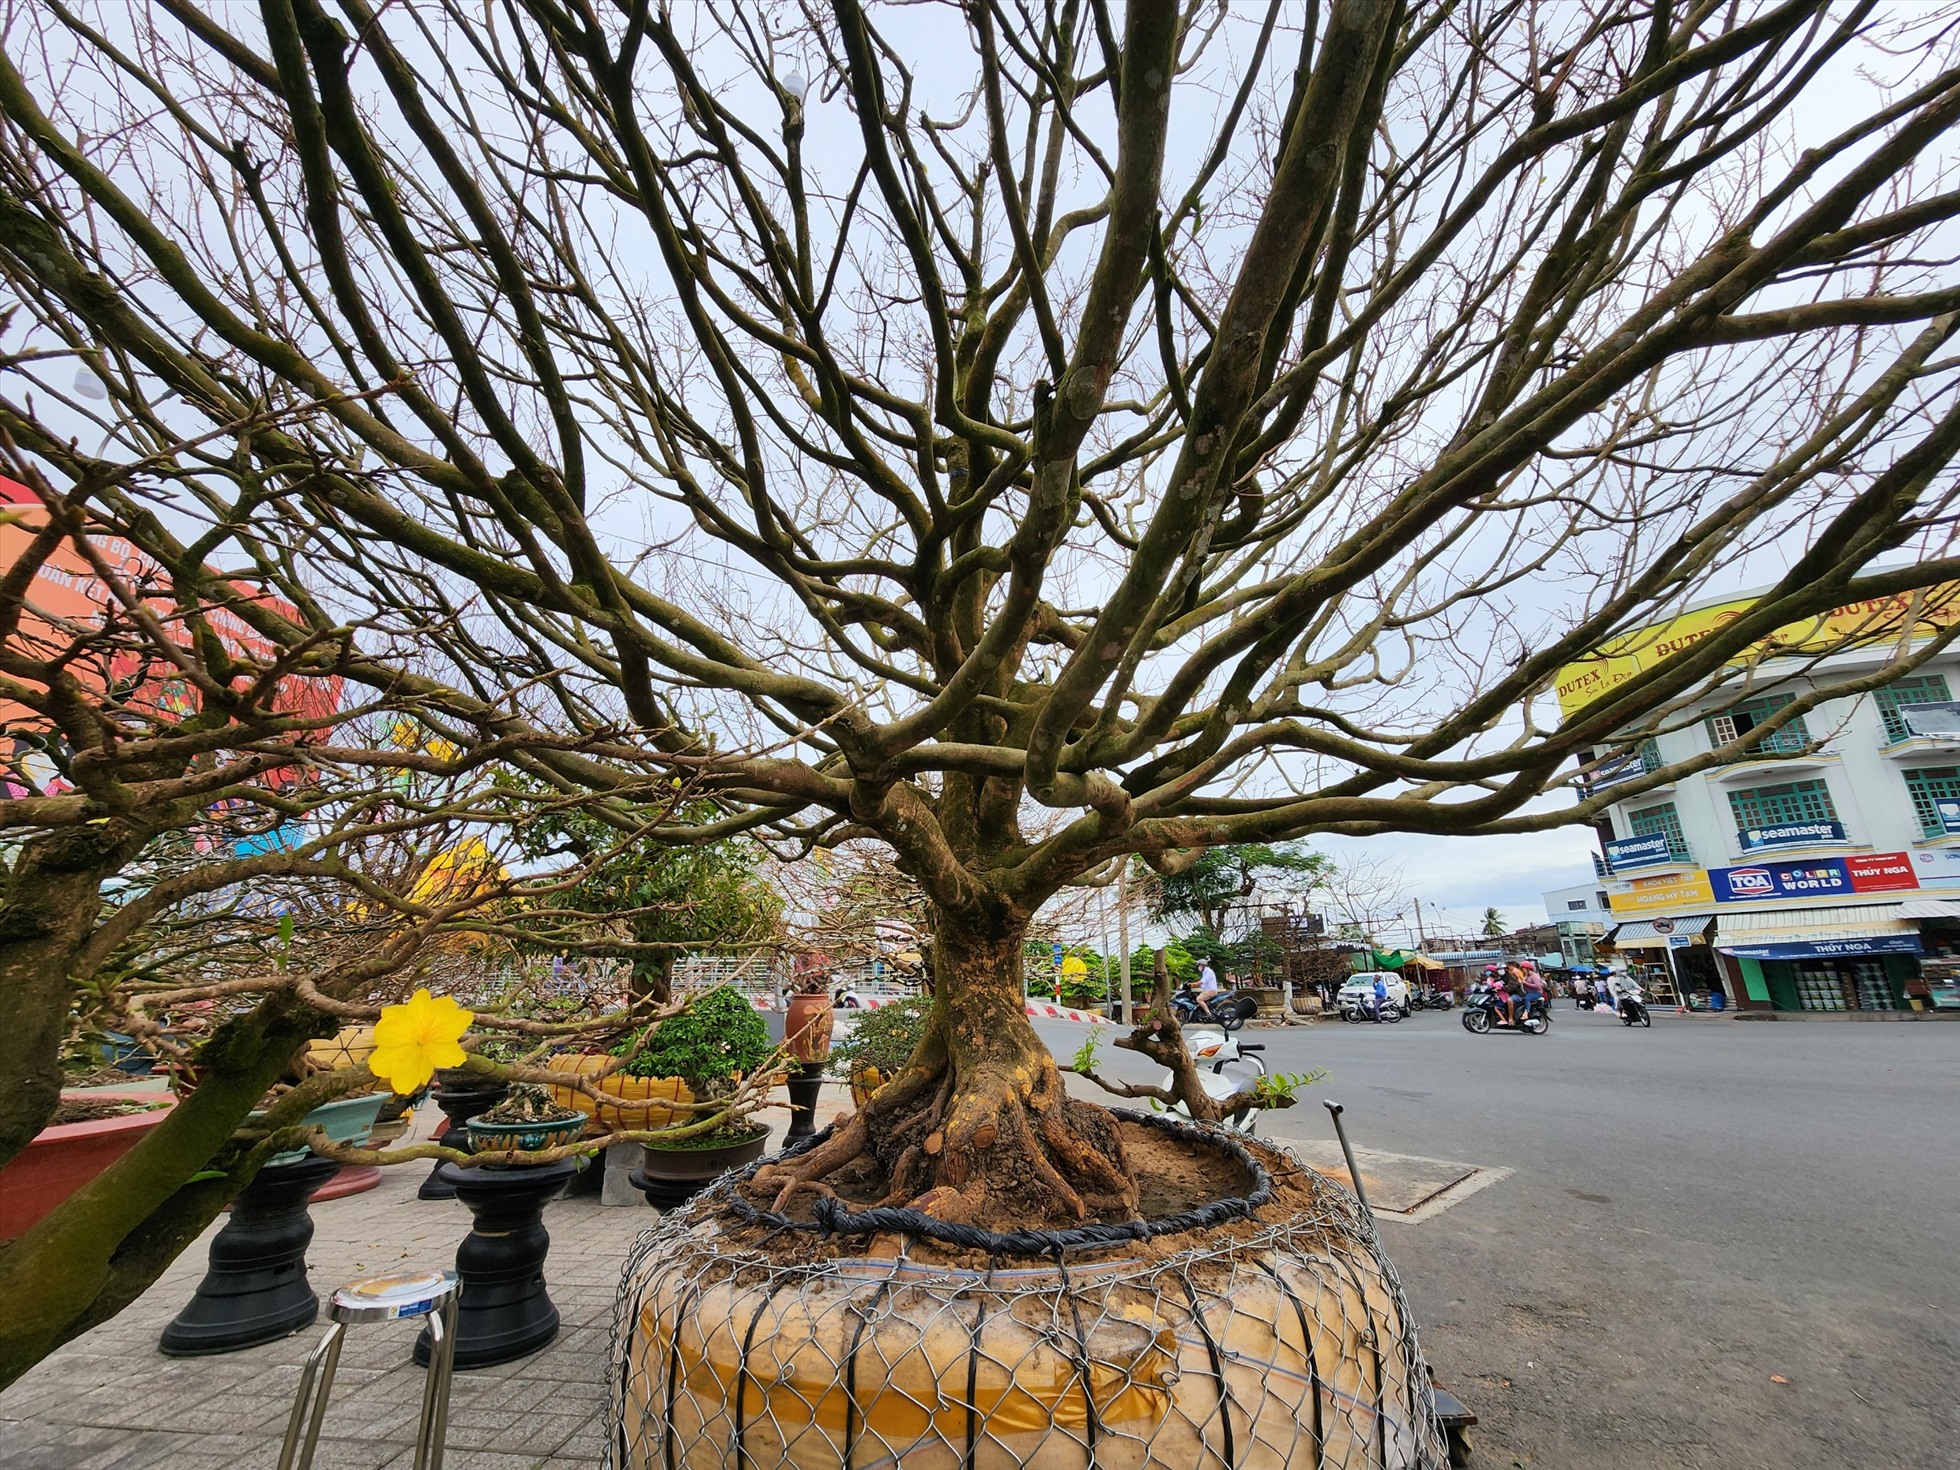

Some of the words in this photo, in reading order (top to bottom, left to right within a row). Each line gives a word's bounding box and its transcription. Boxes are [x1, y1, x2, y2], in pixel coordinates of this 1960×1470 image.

[1559, 669, 1601, 698] DUTEX
[1761, 824, 1833, 840] seamaster
[1619, 839, 1665, 854] seamaster
[1780, 869, 1841, 880] COLOR
[1883, 866, 1908, 875] NGA
[1732, 876, 1769, 888] TOA
[1782, 878, 1842, 890] WORLD
